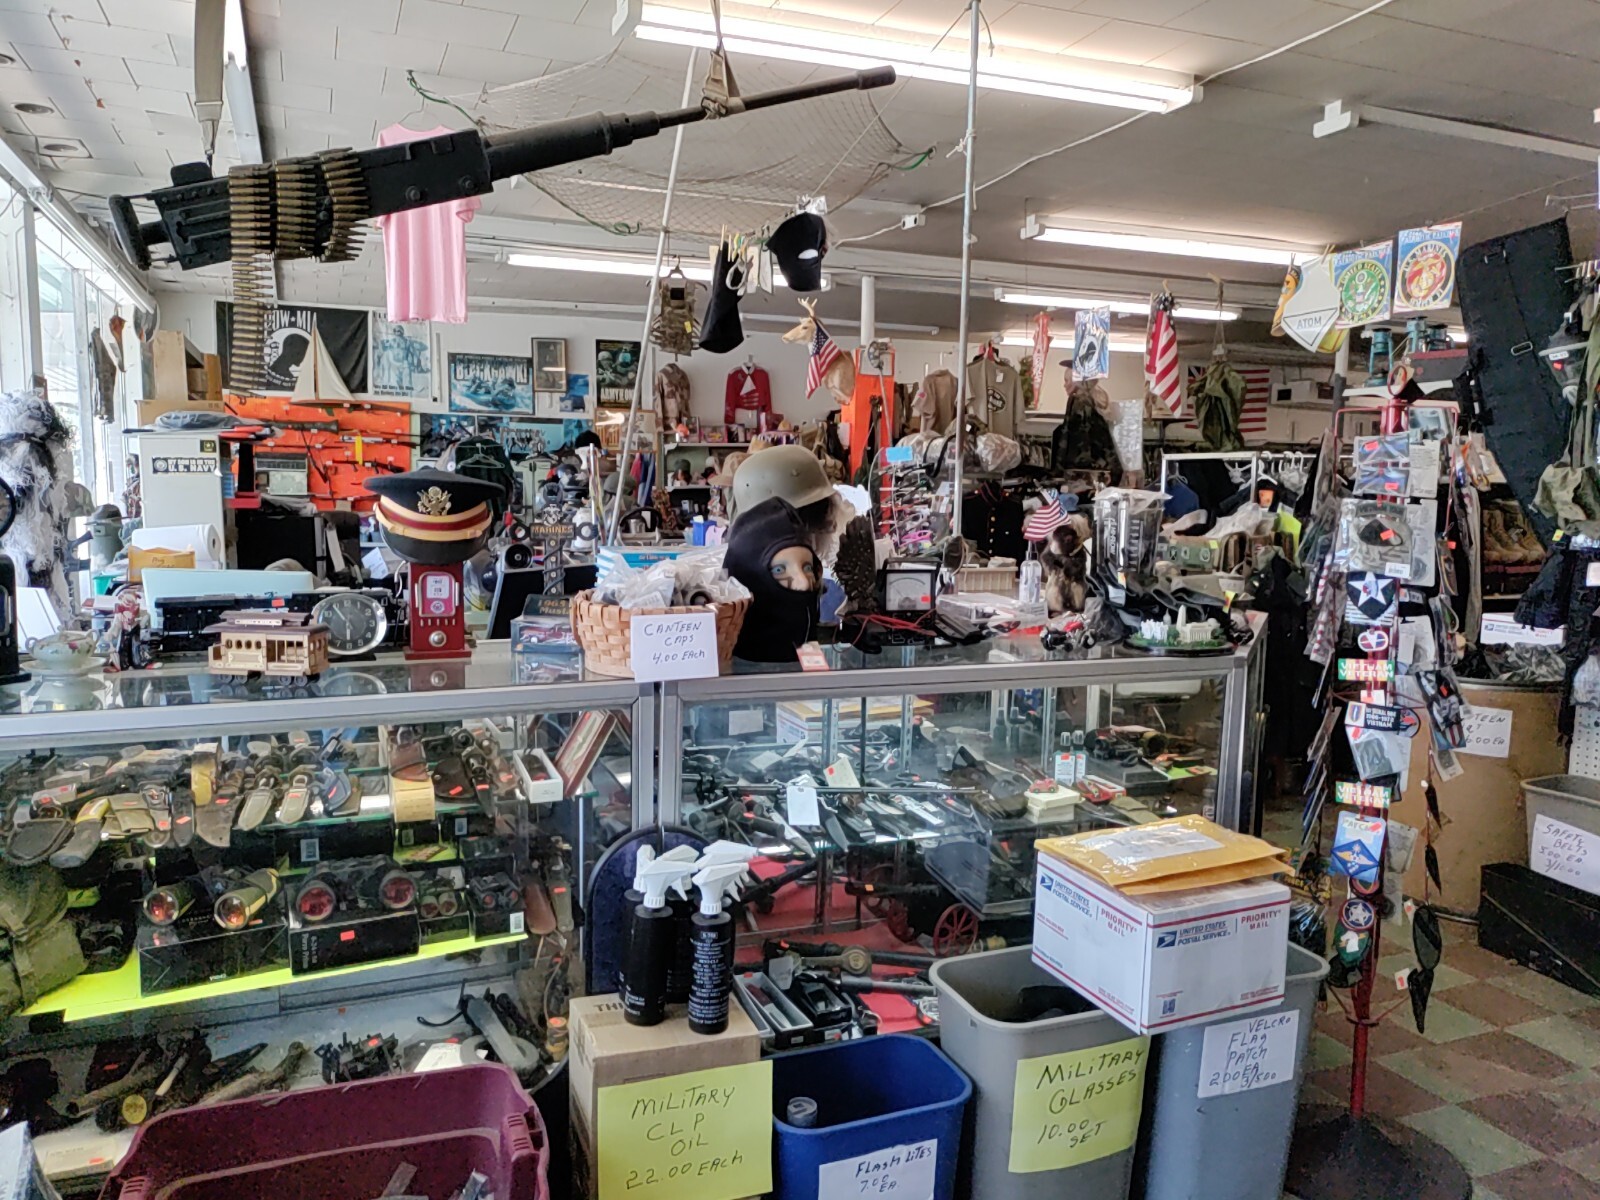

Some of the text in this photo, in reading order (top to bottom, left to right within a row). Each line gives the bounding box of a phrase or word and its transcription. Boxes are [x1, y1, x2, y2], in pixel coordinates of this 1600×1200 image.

[1296, 315, 1322, 330] ATOM
[532, 525, 573, 534] MARINES
[365, 608, 372, 616] 2
[644, 621, 702, 636] CANTEEN
[664, 634, 694, 646] CAPS
[653, 652, 678, 664] 4.00
[1340, 670, 1393, 678] VETERAN
[1341, 662, 1392, 671] VIETNAM
[1367, 720, 1392, 728] VIETNAM
[1475, 713, 1506, 722] TEEN
[1542, 824, 1584, 848] SAFETY
[1554, 838, 1588, 856] BELTS
[1052, 888, 1070, 904] POSTAL
[1054, 880, 1090, 906] UNITED STATES
[1101, 908, 1134, 933] PRIORITY
[1240, 910, 1278, 924] PRIORITY
[1108, 922, 1125, 936] MAIL
[1180, 920, 1226, 936] UNITED STATES
[1250, 922, 1268, 930] MAIL
[1178, 935, 1200, 946] POSTAL
[1248, 1016, 1291, 1034] VELCRO
[1226, 1046, 1268, 1070] PATCH
[1049, 1069, 1136, 1114] GLASSES
[1038, 1120, 1090, 1144] 10.00
[1070, 1122, 1108, 1148] SET
[626, 1162, 694, 1190] 22.00
[860, 1174, 888, 1192] 7.00
